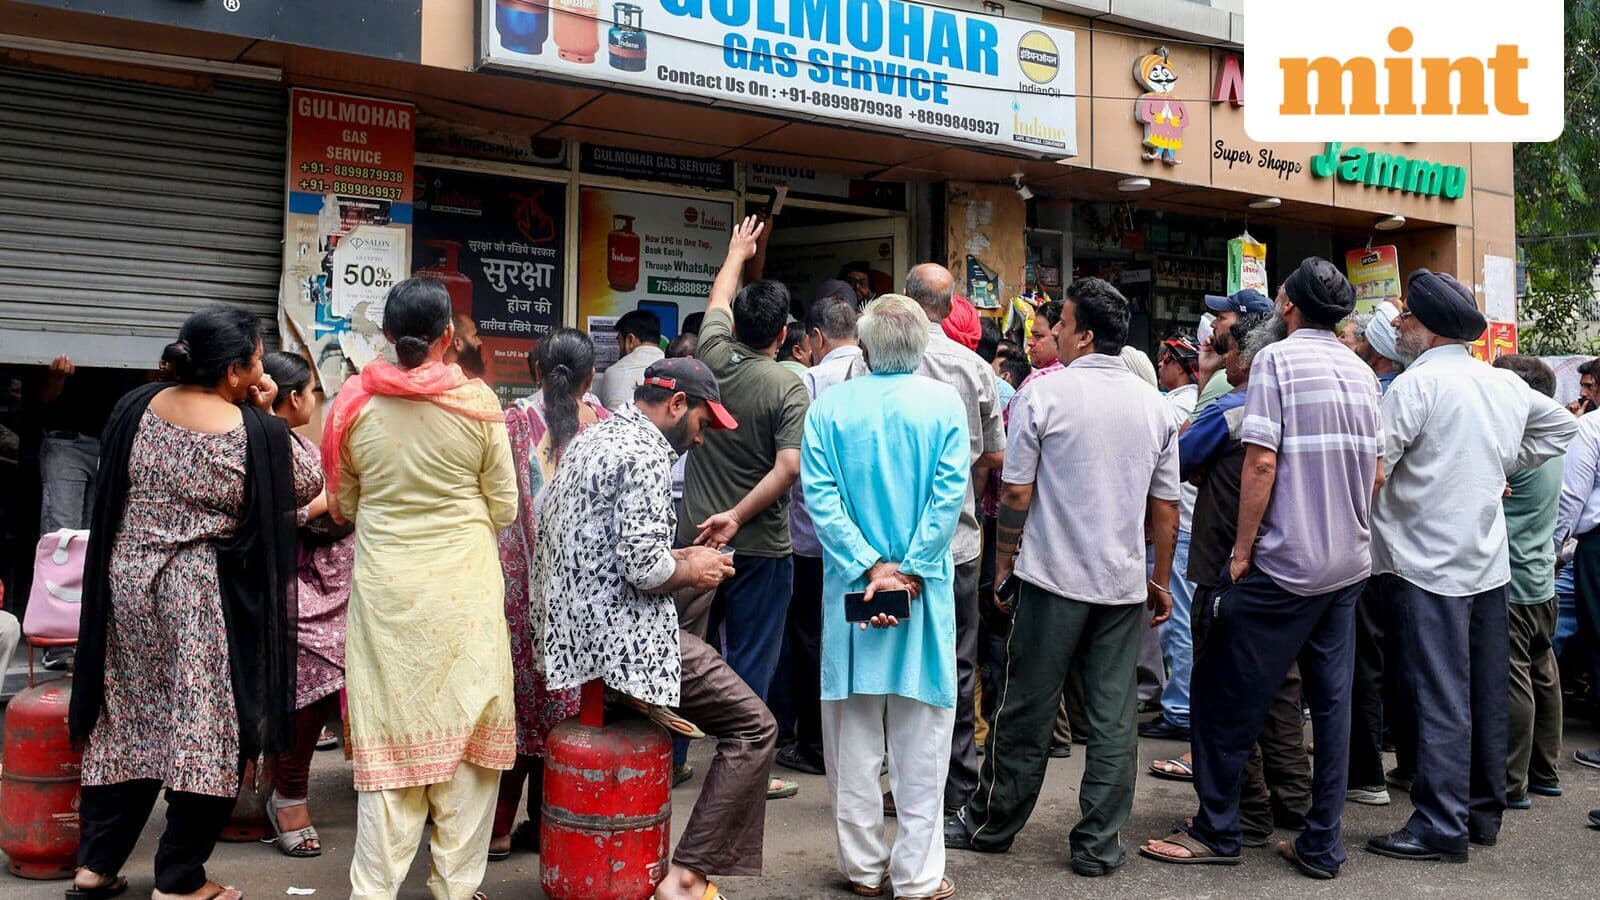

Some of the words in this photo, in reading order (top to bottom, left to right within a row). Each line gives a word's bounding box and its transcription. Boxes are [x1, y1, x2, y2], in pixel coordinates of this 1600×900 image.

[723, 33, 797, 78] GAS
[808, 48, 949, 105] SERVICE
[1019, 82, 1061, 98] IndianOil
[657, 65, 723, 90] Contact
[726, 77, 745, 94] Us
[749, 81, 768, 97] On
[779, 88, 902, 120] +91-8899879938
[908, 109, 1000, 136] +8899849937
[298, 97, 411, 129] GULMOHAR
[342, 129, 368, 145] GAS
[326, 145, 382, 164] SERVICE
[593, 148, 654, 166] GULMOHAR
[656, 156, 677, 170] GAS
[679, 160, 721, 175] SERVICE
[1213, 140, 1253, 169] Super
[1258, 149, 1302, 180] Shoppe
[301, 162, 330, 174] +91-
[1310, 142, 1466, 199] Jammu
[300, 179, 329, 191] +91-
[333, 182, 402, 199] 8899849937
[365, 239, 390, 248] SALON
[468, 240, 492, 253] सुरक्षा
[494, 241, 505, 253] को
[505, 242, 529, 255] रखिये
[645, 234, 660, 243] Now
[661, 235, 674, 245] LPG
[675, 237, 682, 245] in
[684, 238, 696, 247] One
[645, 246, 663, 255] Book
[663, 247, 684, 258] Easily
[343, 264, 392, 287] 50%
[480, 257, 555, 293] सुरक्षा
[645, 261, 672, 273] Through
[673, 260, 720, 277] WhatsApp
[375, 280, 394, 288] OFF
[506, 295, 531, 315] होज
[534, 297, 552, 315] की
[480, 318, 507, 331] तारीख
[507, 320, 532, 333] रखिये
